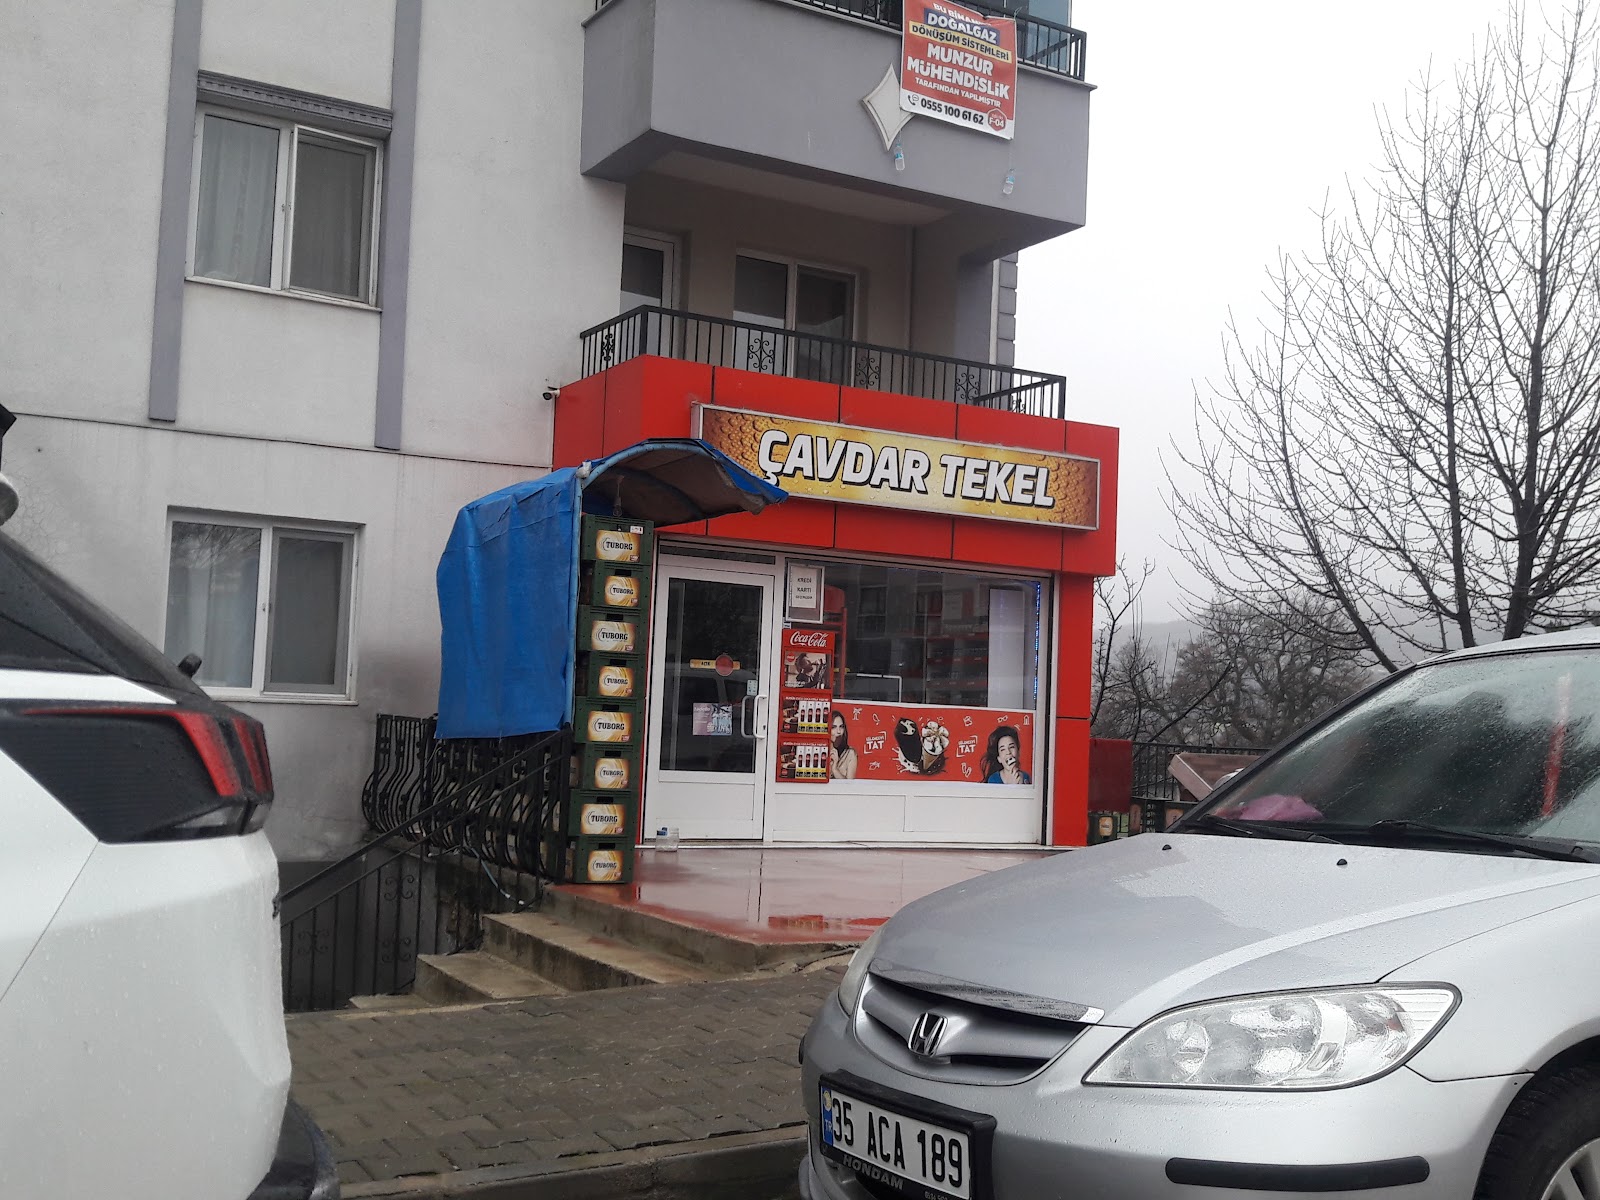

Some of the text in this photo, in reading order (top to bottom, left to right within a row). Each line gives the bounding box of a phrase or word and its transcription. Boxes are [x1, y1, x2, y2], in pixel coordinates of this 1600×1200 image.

[927, 12, 998, 44] DOĞALGAZ
[911, 24, 1009, 61] DÖNÜŞÜM SİSTEMLERİ
[927, 42, 994, 76] MUNZUR
[906, 56, 1010, 100] MÜHENDİSLİK
[915, 77, 1002, 108] TARAFINDAN YAPILMIŞTIR
[920, 98, 943, 113] 0555
[944, 104, 960, 119] 100
[962, 110, 972, 121] 61
[973, 114, 985, 125] 62
[758, 428, 1055, 509] ÇAVDAR TEKEL
[606, 541, 633, 551] TUBORG
[612, 586, 634, 595] TUBORG
[601, 632, 628, 641] TUBORG
[790, 630, 829, 648] Coca-Cola
[607, 678, 629, 686] TUBORG
[598, 722, 625, 731] TUBORG
[867, 741, 884, 750] TAT
[959, 745, 976, 754] TAT
[602, 769, 624, 777] TUBORG
[591, 815, 618, 824] TUBORG
[595, 862, 617, 870] TUBORG
[824, 1118, 833, 1133] TR
[832, 1097, 963, 1188] 35 ACA 189
[842, 1154, 905, 1191] HONDAM
